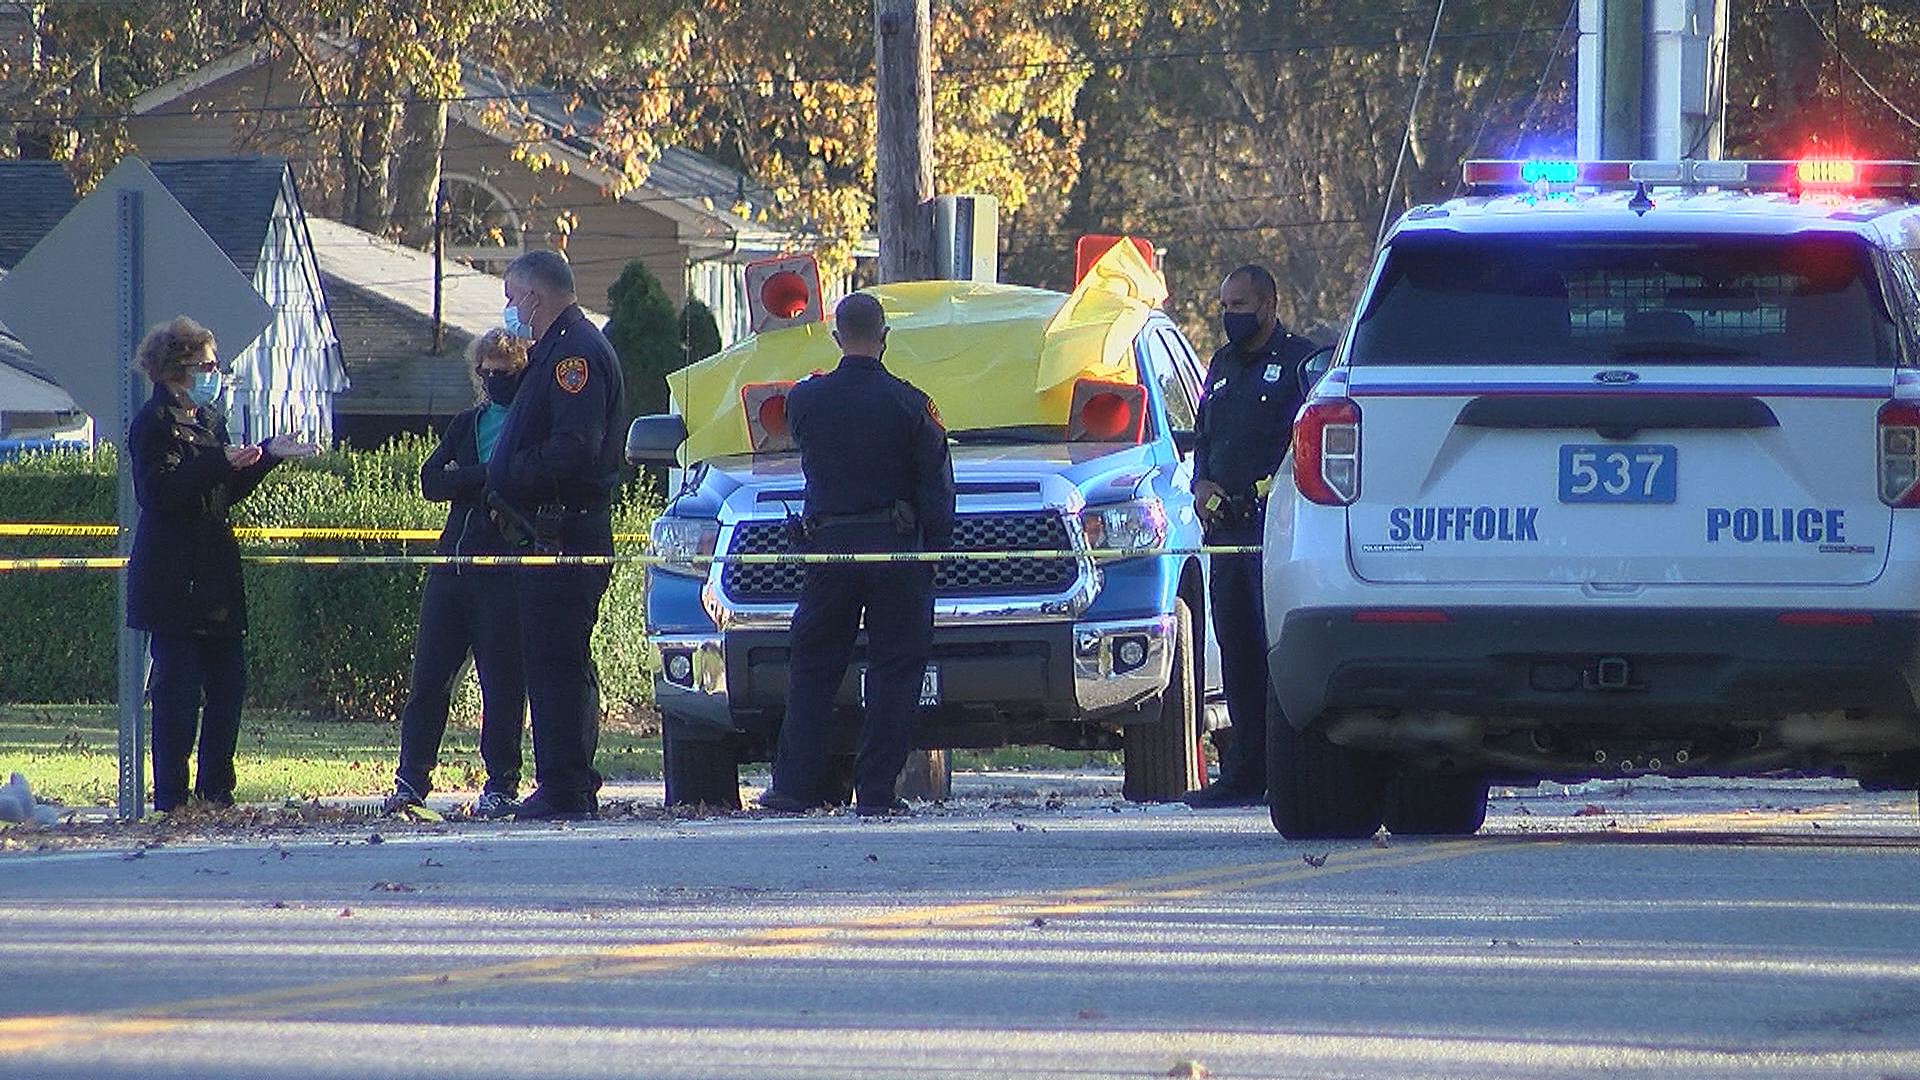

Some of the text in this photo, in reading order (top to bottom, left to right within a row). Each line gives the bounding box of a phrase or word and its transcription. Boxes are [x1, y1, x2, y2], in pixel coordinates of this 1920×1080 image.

[1571, 452, 1663, 495] 537
[1389, 506, 1846, 543] SUFFOLK POLICE
